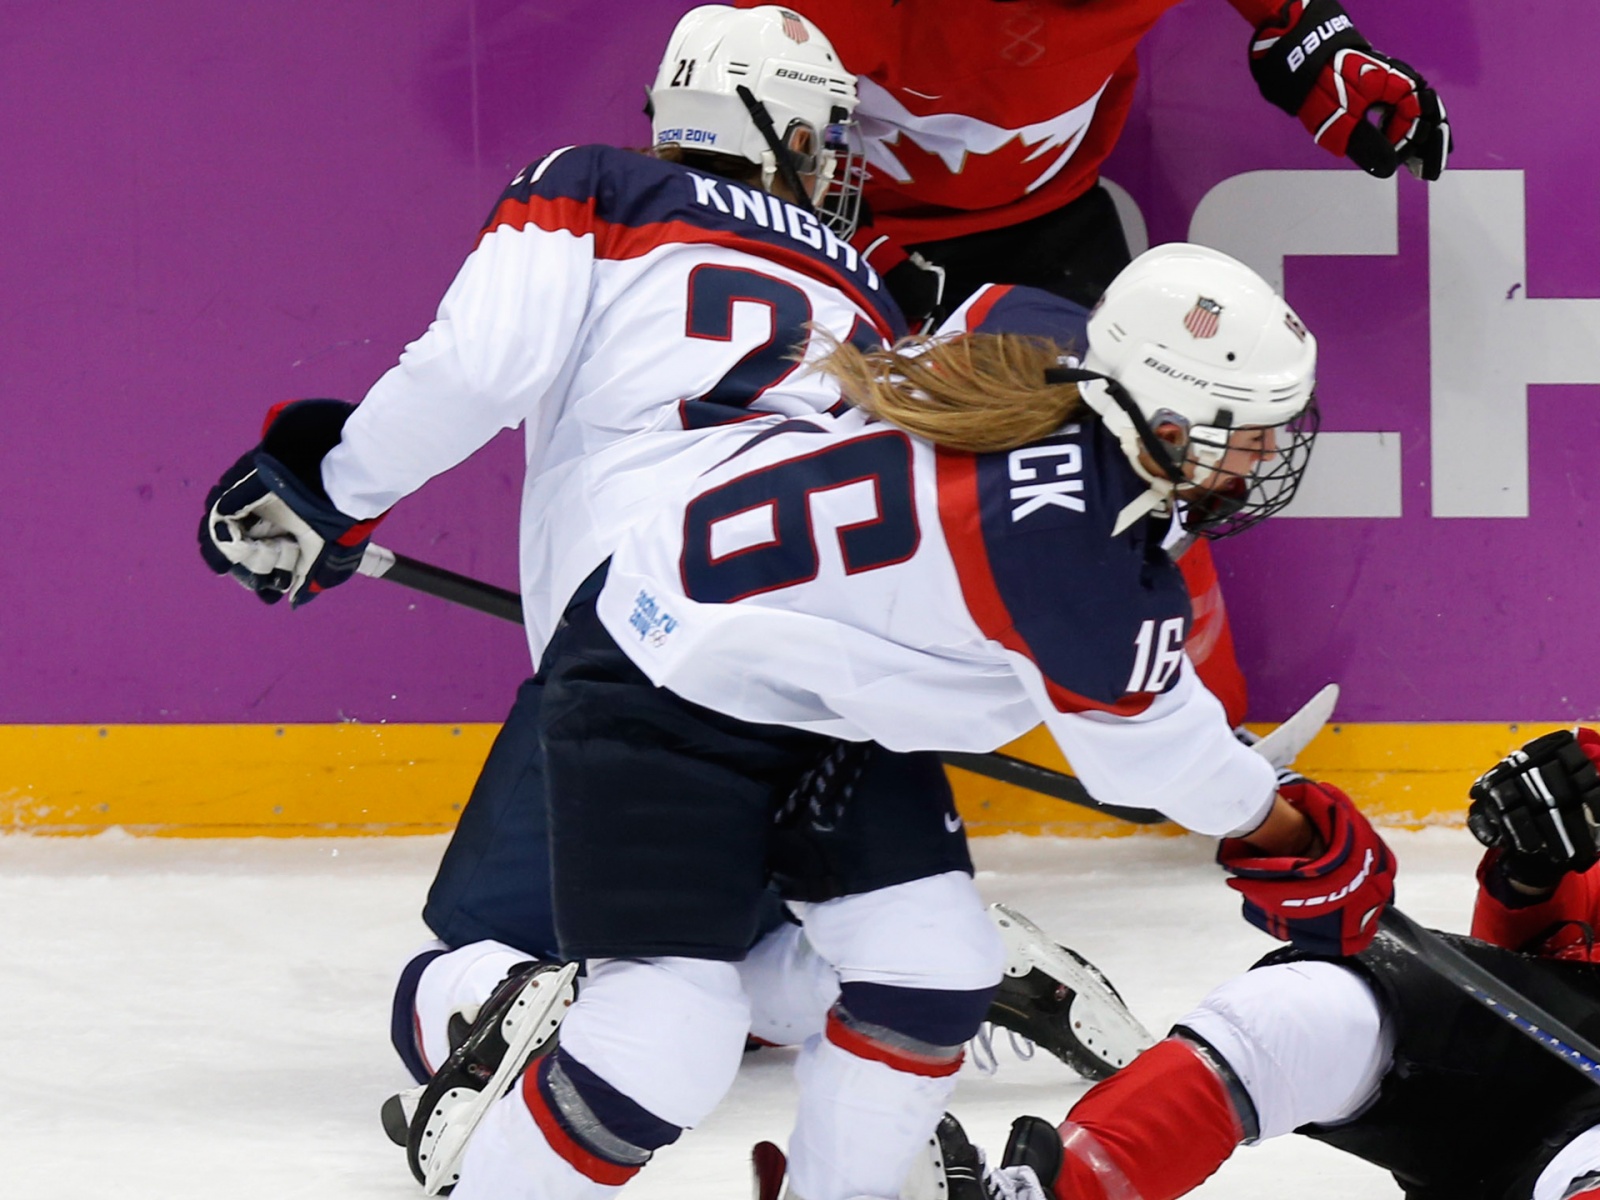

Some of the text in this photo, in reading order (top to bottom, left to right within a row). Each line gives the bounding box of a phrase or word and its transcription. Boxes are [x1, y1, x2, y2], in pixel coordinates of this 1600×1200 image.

[670, 59, 696, 88] 21
[658, 128, 718, 145] SOCHI 2014
[1126, 617, 1184, 693] 16
